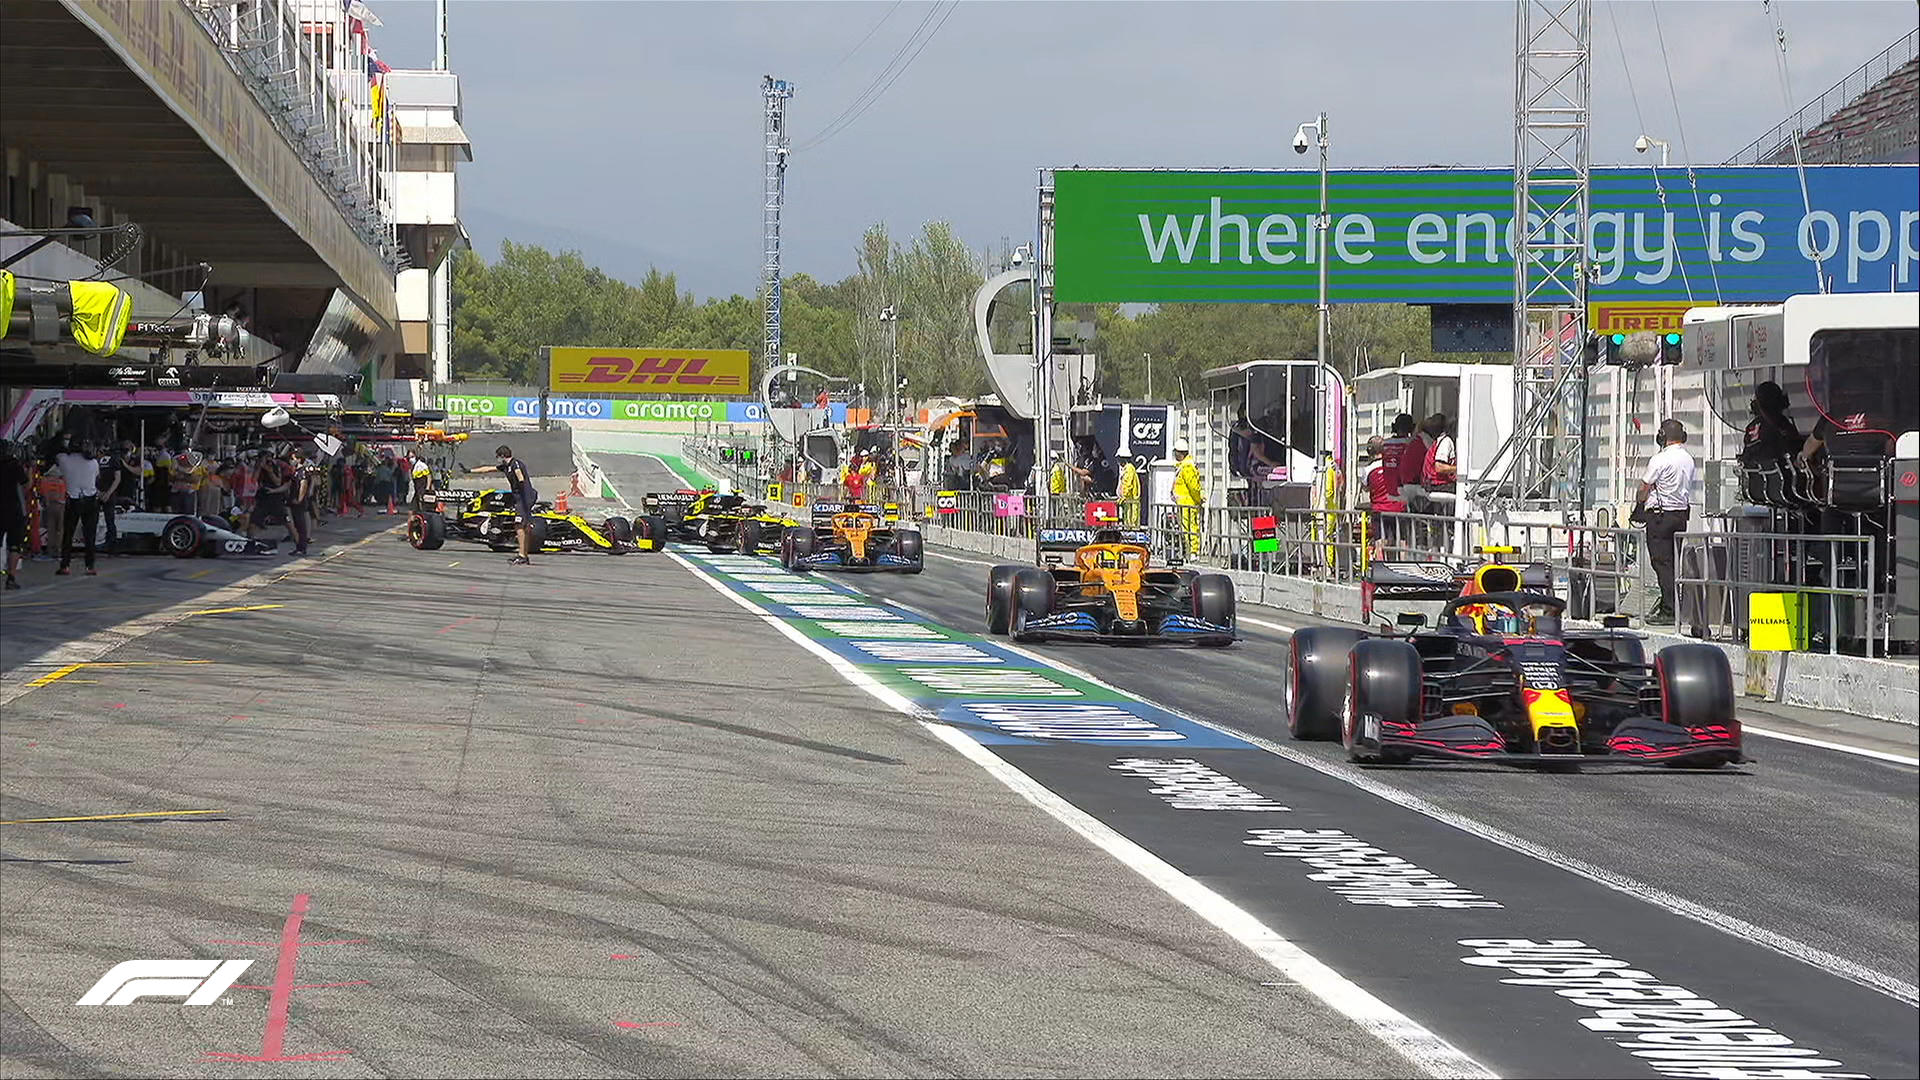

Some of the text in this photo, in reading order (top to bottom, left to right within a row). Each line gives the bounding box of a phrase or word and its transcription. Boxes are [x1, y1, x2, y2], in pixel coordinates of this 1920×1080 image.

[1138, 196, 1373, 265] where
[1406, 202, 1674, 283] energy
[1707, 193, 1764, 262] is
[584, 356, 717, 386] DHL
[624, 402, 713, 419] aramco
